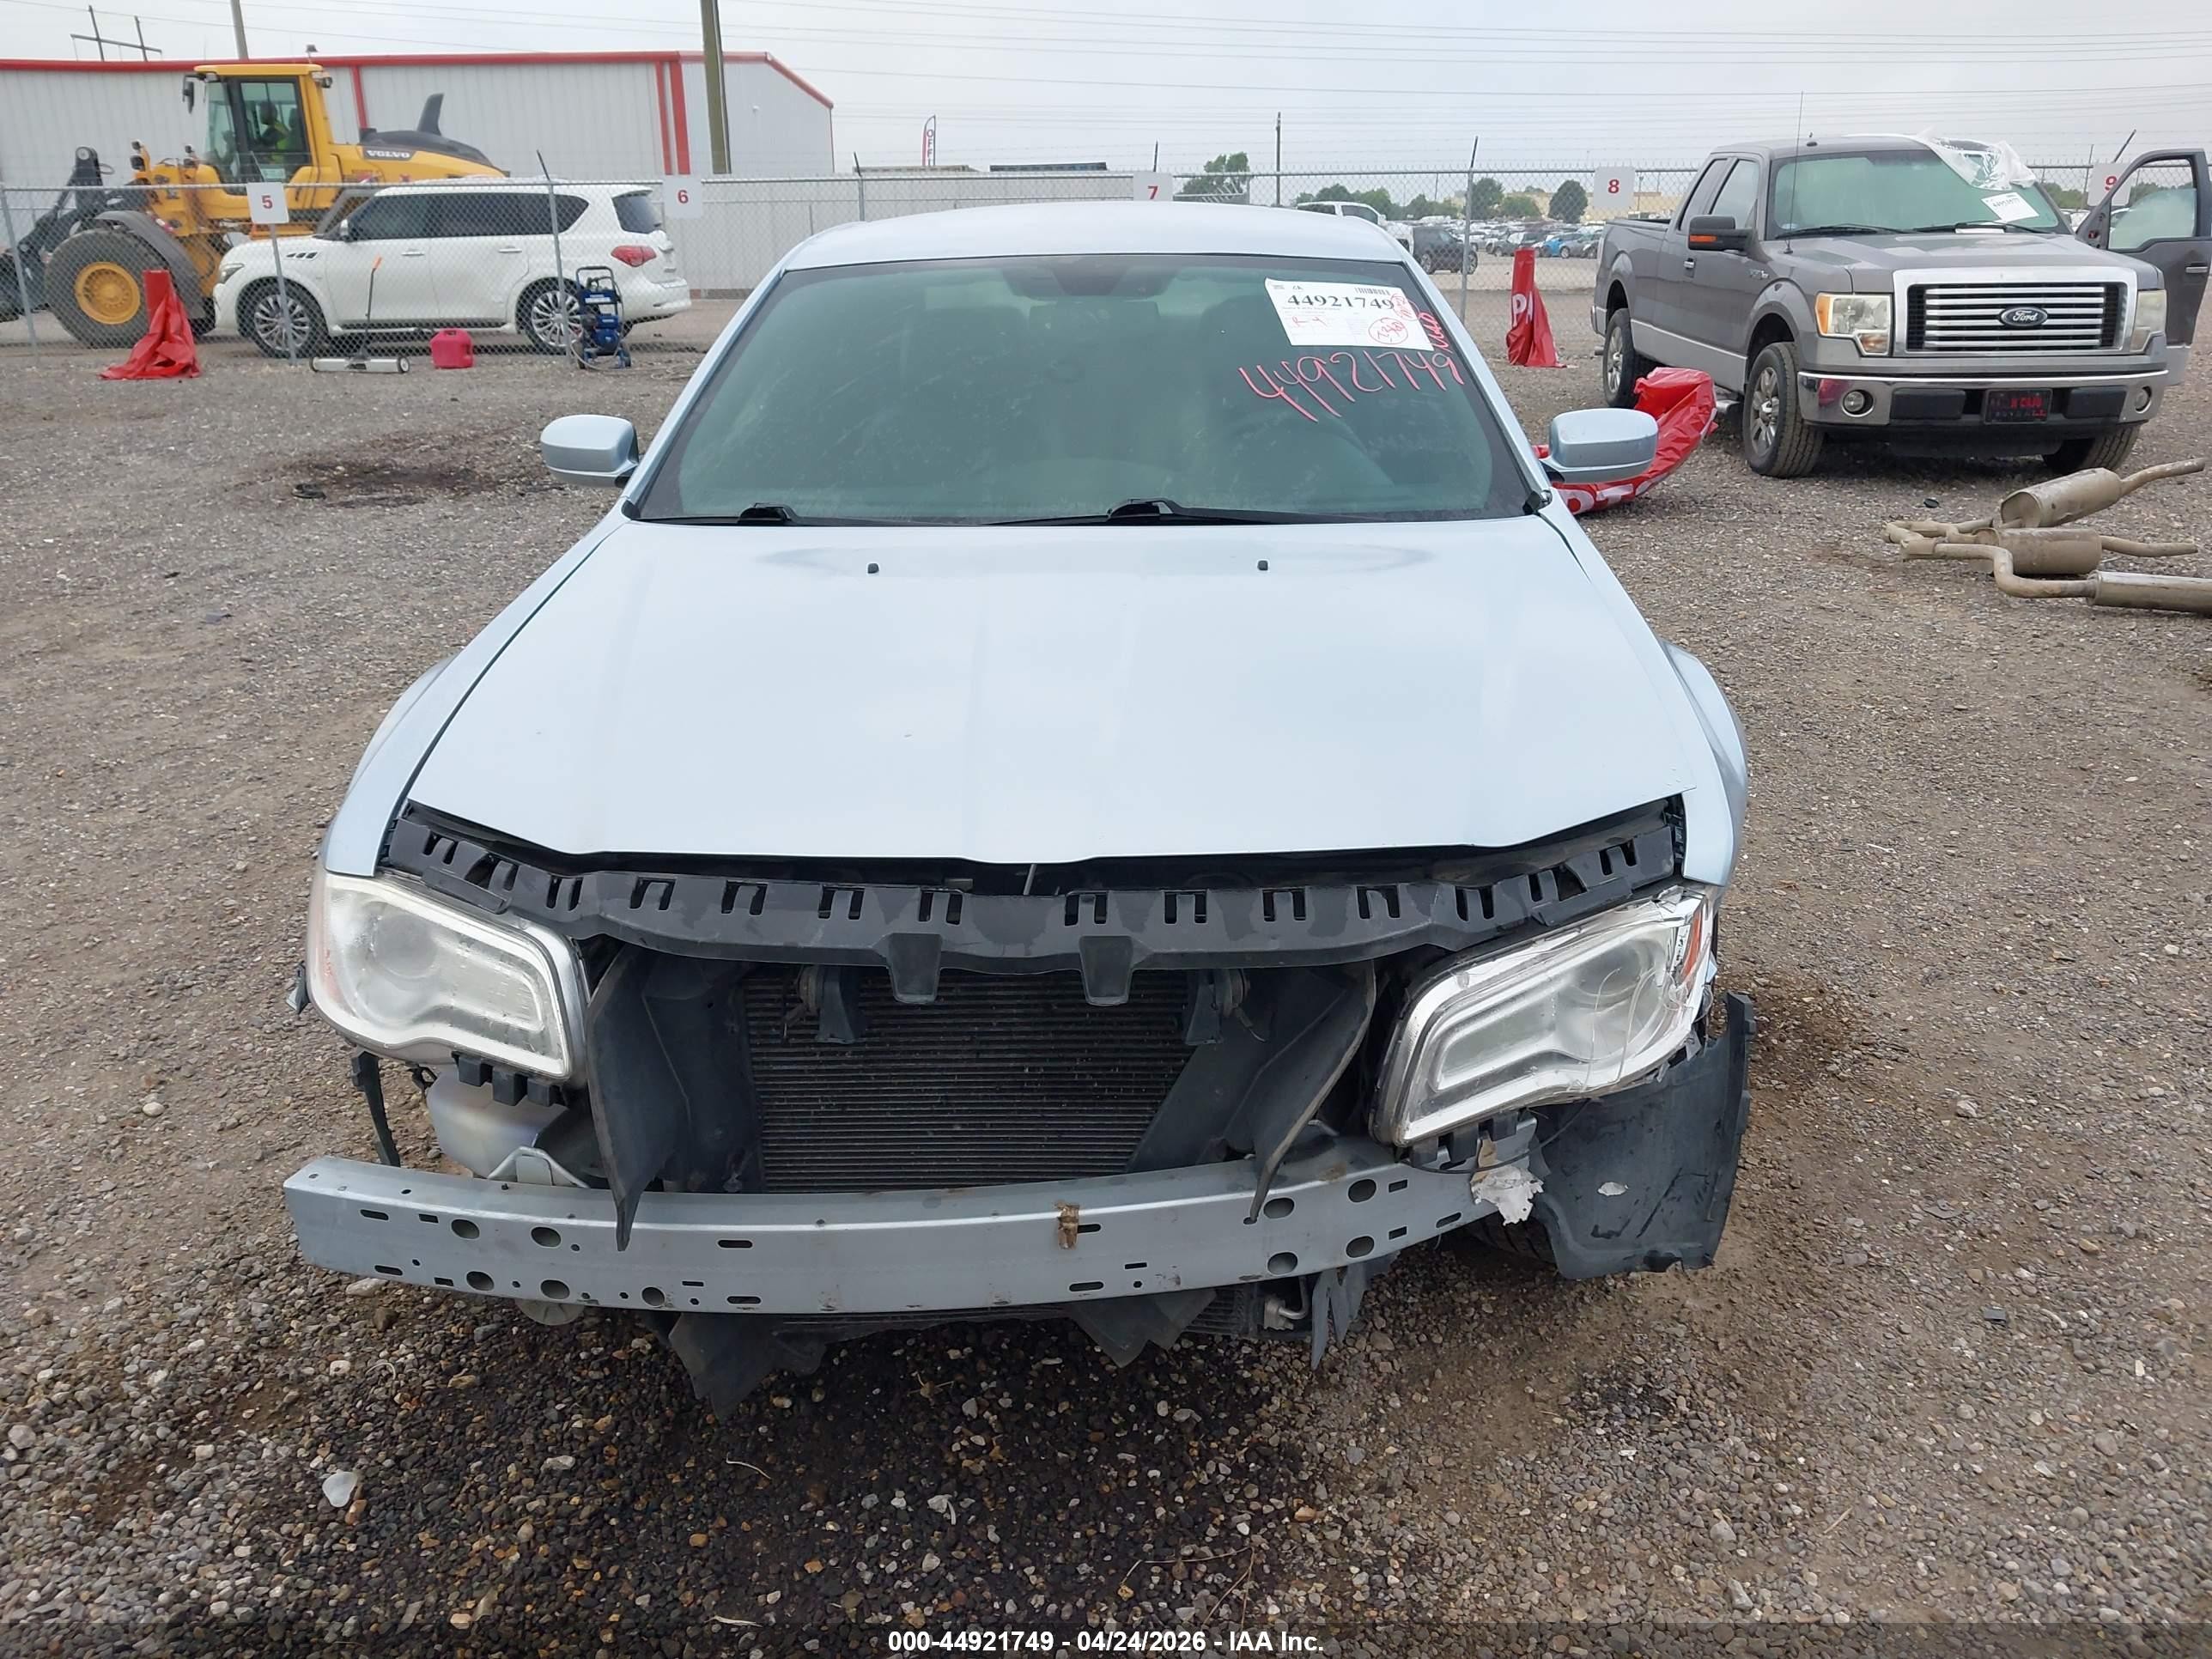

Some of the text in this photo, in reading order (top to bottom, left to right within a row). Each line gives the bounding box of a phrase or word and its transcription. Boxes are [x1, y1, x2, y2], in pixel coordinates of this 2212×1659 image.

[367, 149, 410, 159] VOLVO
[1607, 179, 1620, 194] 8
[2105, 175, 2118, 191] 9
[678, 189, 689, 204] 6
[1147, 185, 1158, 200] 7
[261, 195, 273, 210] 5
[1287, 294, 1395, 310] 44921749
[2012, 310, 2039, 322] Ford
[1237, 349, 1465, 422] 44921749
